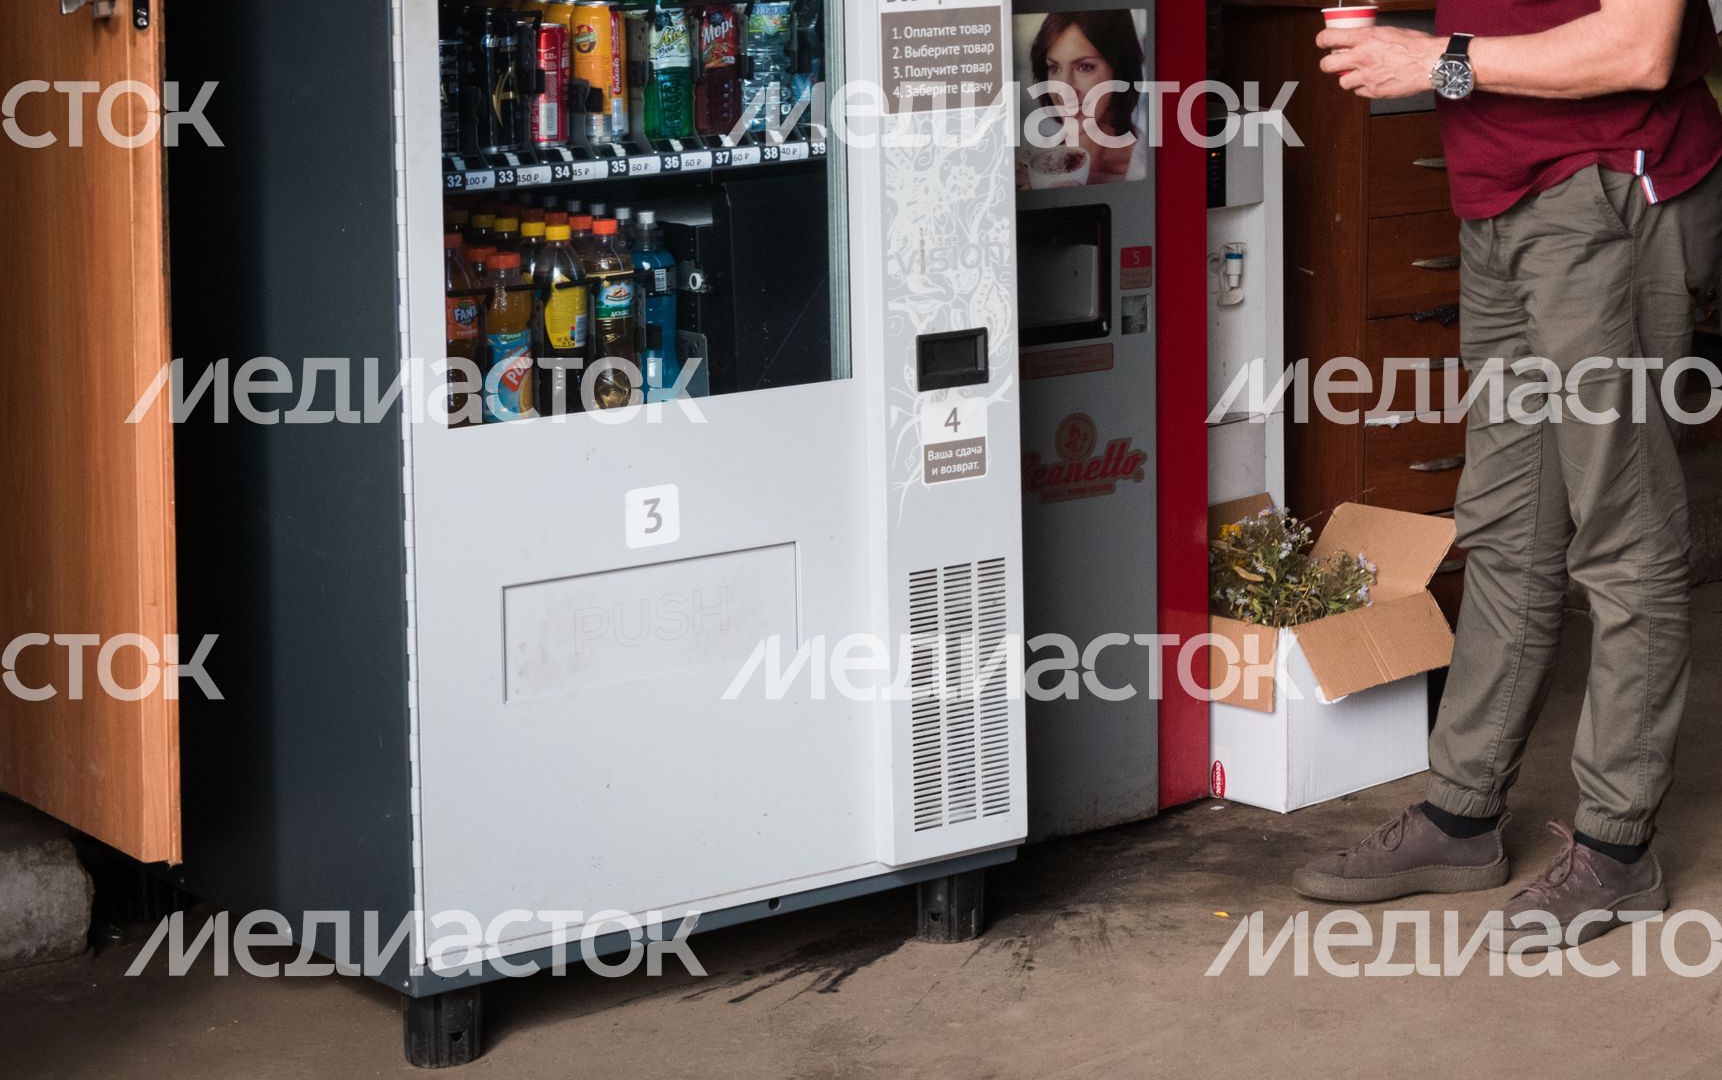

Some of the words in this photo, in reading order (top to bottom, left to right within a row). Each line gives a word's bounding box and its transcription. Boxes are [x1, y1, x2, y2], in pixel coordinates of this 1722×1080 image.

[892, 27, 902, 40] 1.
[904, 26, 957, 39] Оплатите
[959, 23, 992, 36] товар
[892, 48, 903, 59] 2.
[904, 44, 960, 59] Выберите
[963, 42, 994, 55] товар
[893, 66, 903, 79] 3.
[904, 64, 958, 79] Получите
[960, 62, 993, 75] товар
[892, 86, 903, 99] 4.
[905, 84, 958, 98] Заберите
[960, 81, 993, 94] сдачу
[715, 152, 730, 164] 37
[763, 147, 778, 159] 38
[611, 160, 627, 173] 35
[664, 156, 680, 169] 36
[498, 171, 514, 183] 33
[555, 166, 570, 179] 34
[447, 175, 462, 188] 32
[1132, 250, 1140, 265] 5
[944, 406, 961, 433] 4
[927, 449, 953, 461] Ваша
[955, 445, 983, 458] сдача
[931, 467, 938, 476] и
[940, 461, 979, 475] возврат.
[643, 497, 663, 535] 3
[574, 585, 729, 657] PUSH
